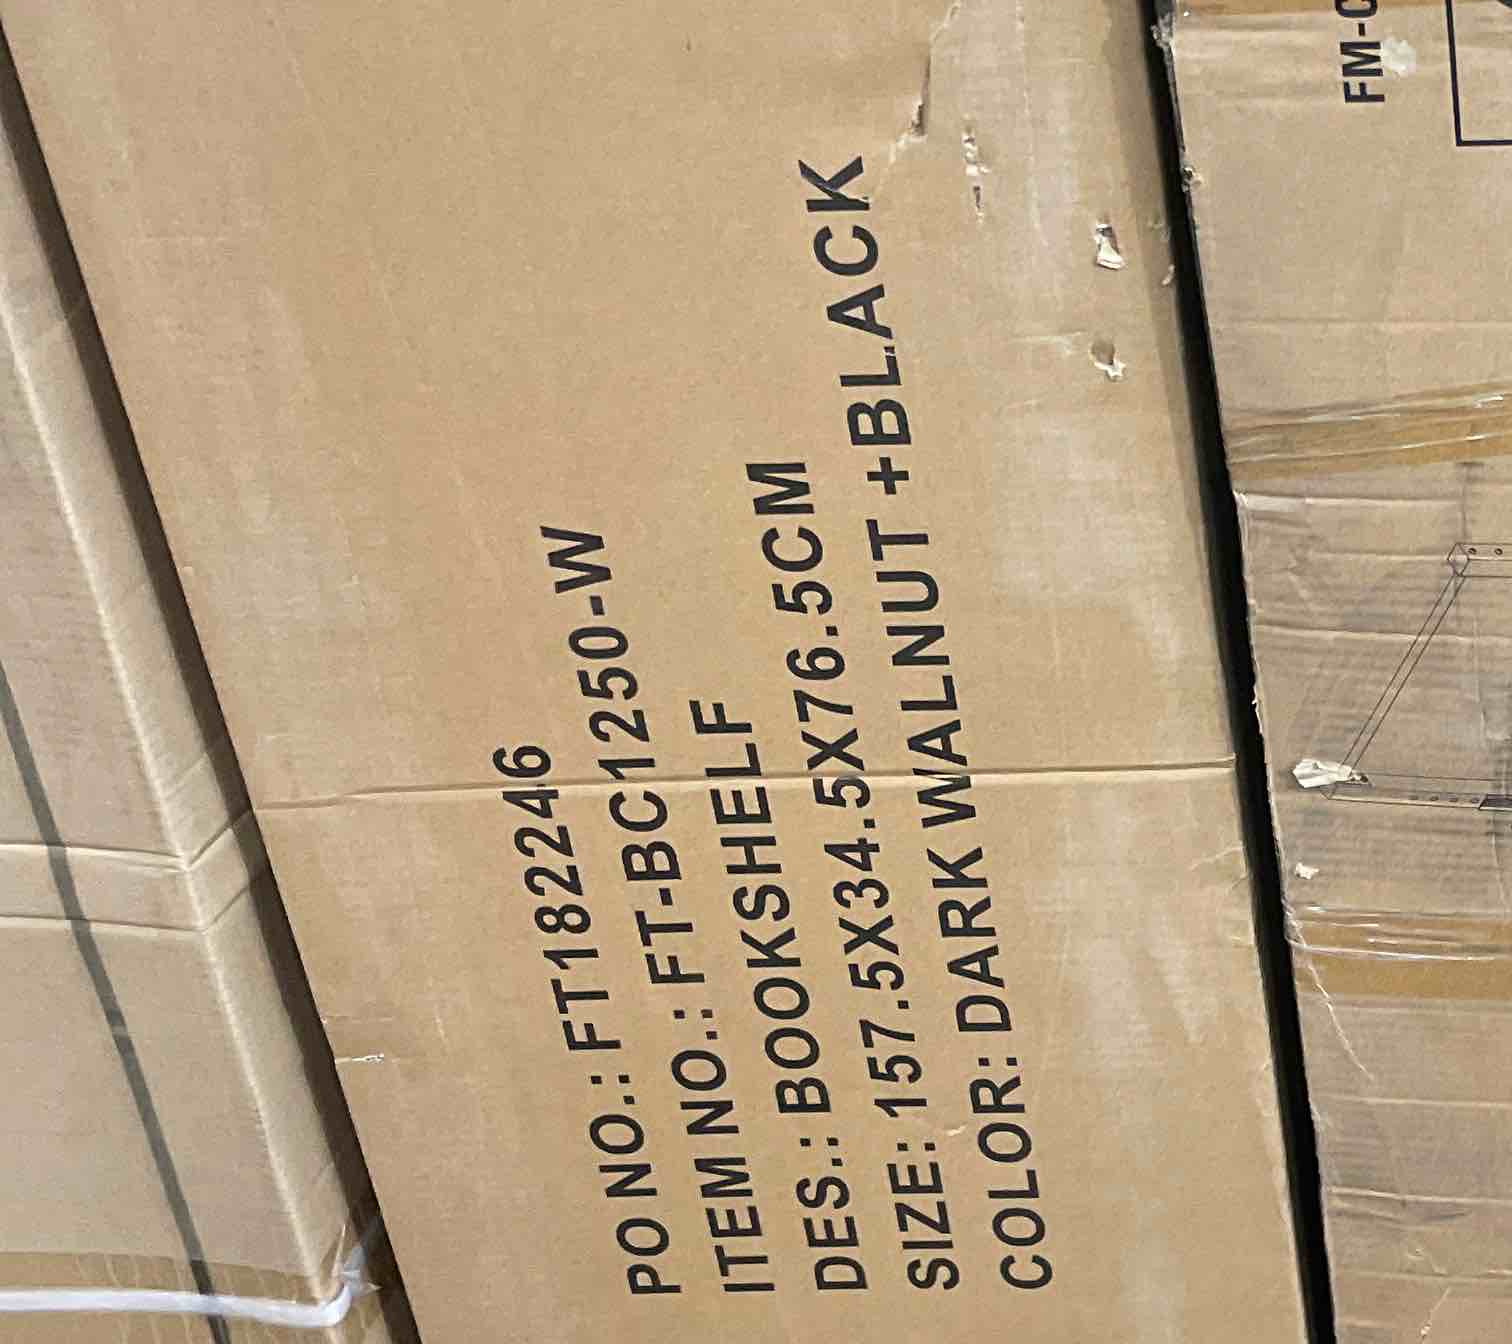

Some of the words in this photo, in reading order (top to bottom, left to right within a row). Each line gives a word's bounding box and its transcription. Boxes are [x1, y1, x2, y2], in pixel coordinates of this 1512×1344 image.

[540, 526, 705, 984] FT-BC1250-W
[866, 519, 977, 828] WALNUT
[745, 461, 928, 1118] 157.5X34.5X76.5CM
[492, 746, 622, 1051] FT182246
[689, 700, 832, 1113] BOOKSHELF
[926, 847, 1012, 1032] DARK
[588, 1074, 658, 1198] NO.:
[671, 1008, 741, 1136] NO.:
[616, 1218, 681, 1294] PO
[694, 1157, 775, 1293] ITEM
[795, 1137, 869, 1291] DES.:
[887, 1141, 960, 1290] SIZE:
[968, 1057, 1053, 1289] COLOR:
